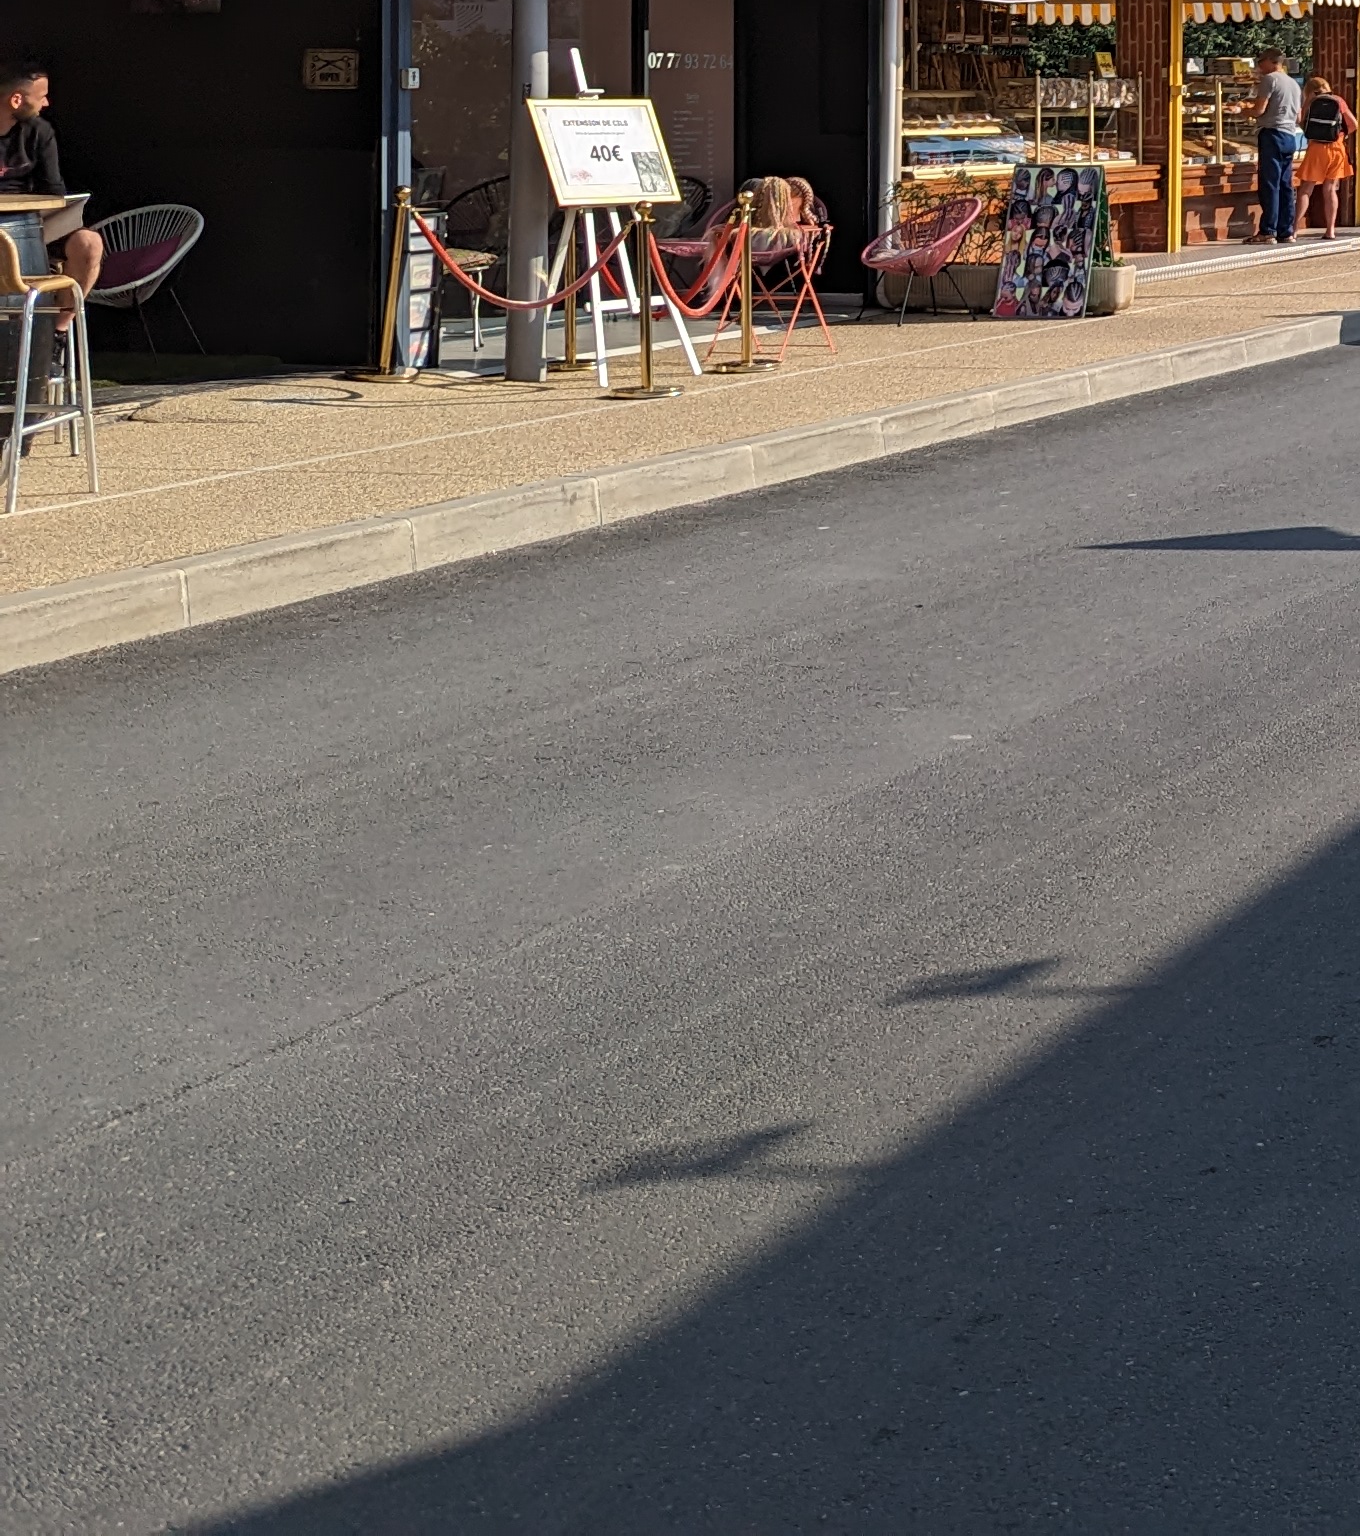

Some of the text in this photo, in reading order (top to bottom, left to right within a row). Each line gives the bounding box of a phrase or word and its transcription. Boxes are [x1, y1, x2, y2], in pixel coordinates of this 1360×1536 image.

[647, 52, 665, 70] 07
[666, 52, 681, 70] 77
[590, 144, 624, 162] 40€
